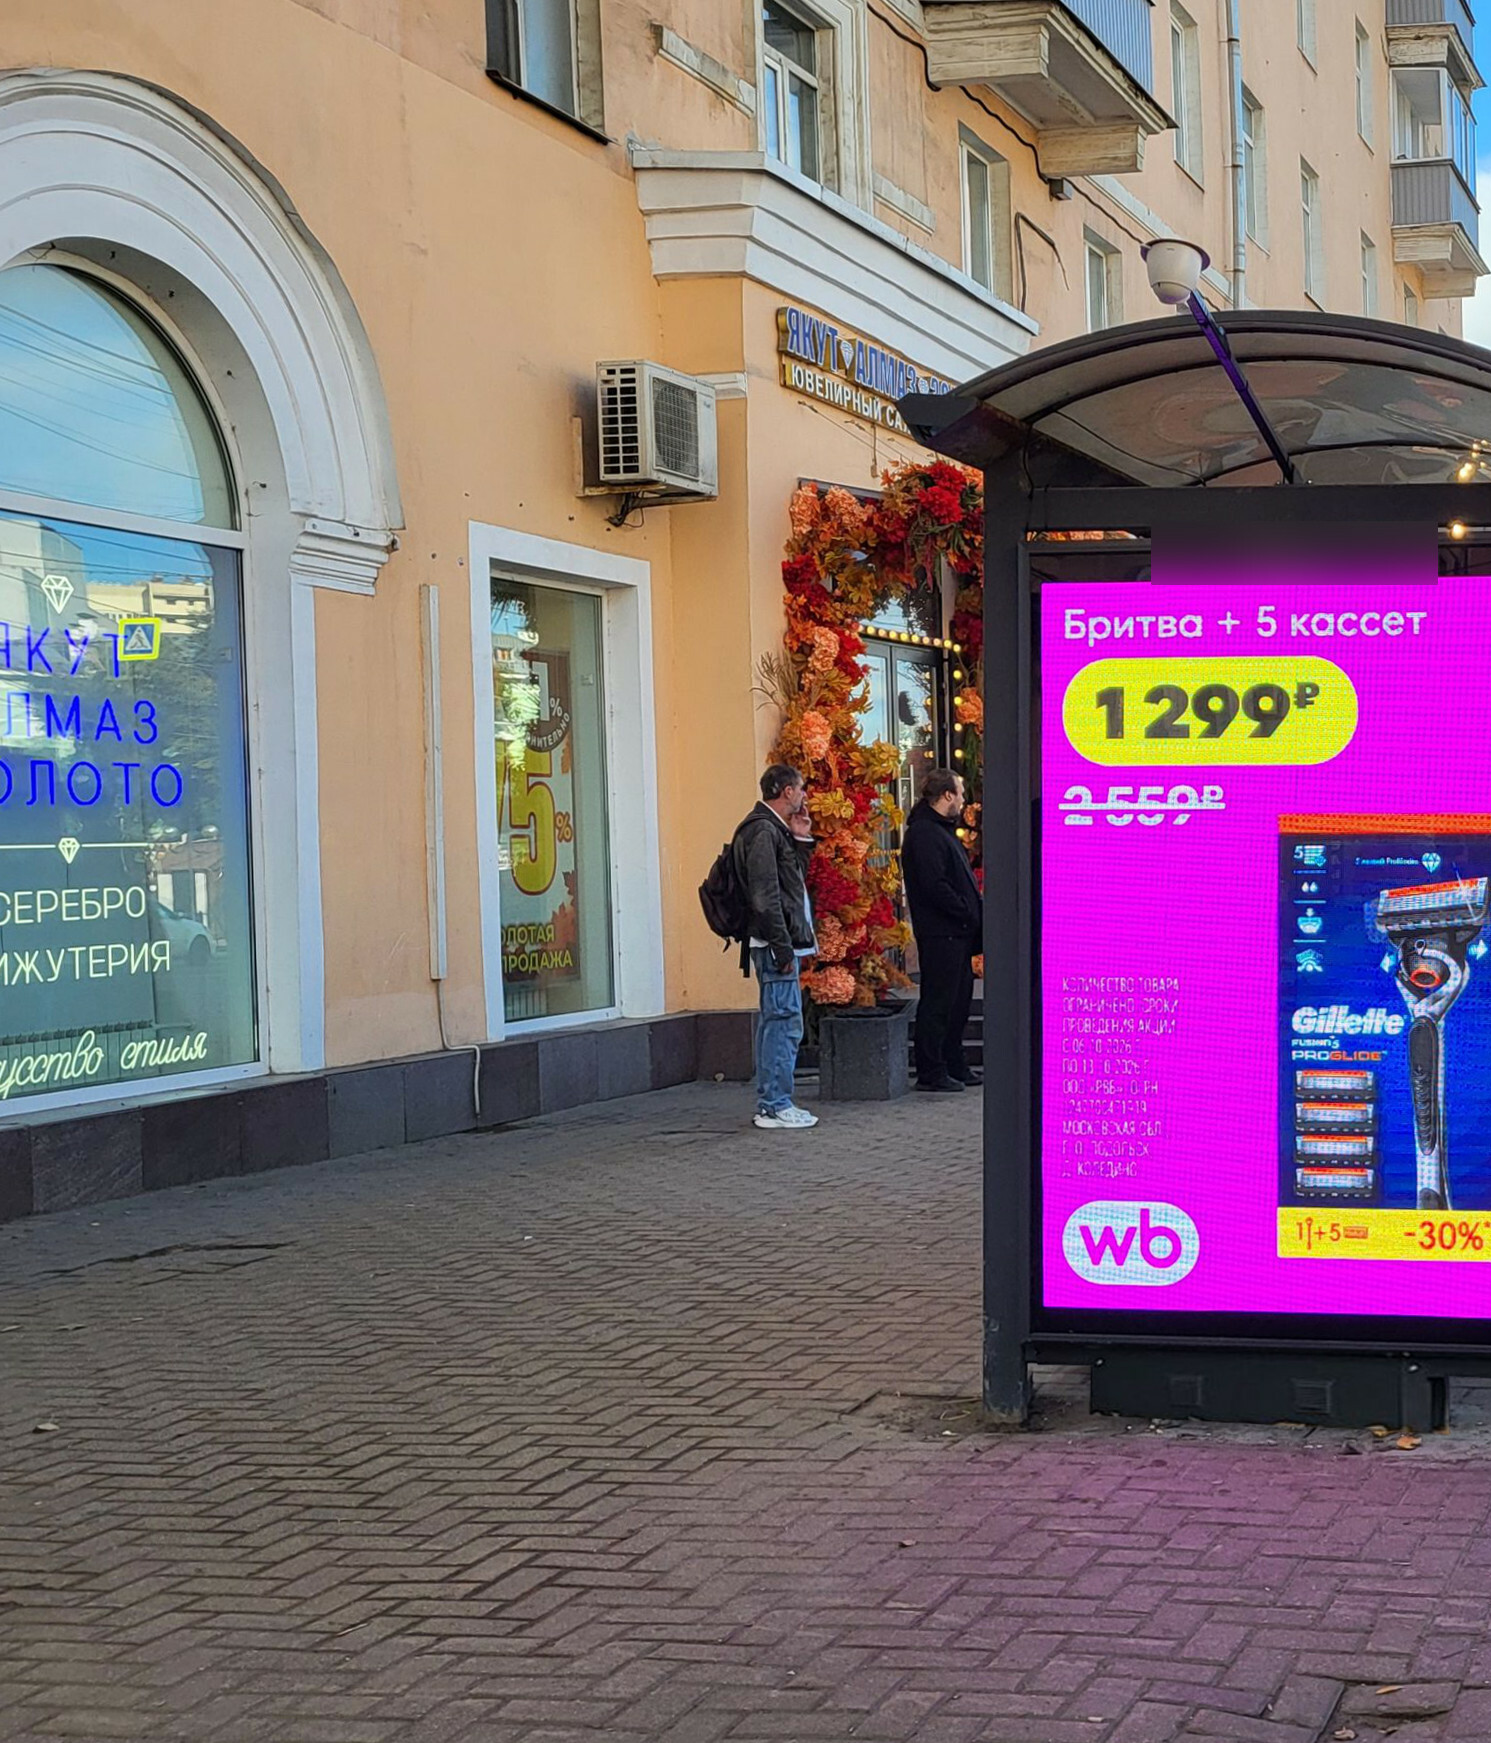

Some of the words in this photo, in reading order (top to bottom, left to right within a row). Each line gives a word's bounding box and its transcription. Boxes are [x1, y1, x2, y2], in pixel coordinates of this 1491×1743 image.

[786, 306, 839, 373] ЯКУТ
[855, 338, 918, 401] АЛМАЗ
[791, 363, 882, 421] ЮВЕЛИРНЫЙ
[1064, 608, 1203, 647] Бритва
[1256, 605, 1277, 637] 5
[1290, 610, 1428, 637] кассет
[1292, 1005, 1405, 1035] Gillette
[120, 1032, 208, 1070] стиля
[1079, 1208, 1182, 1269] wb
